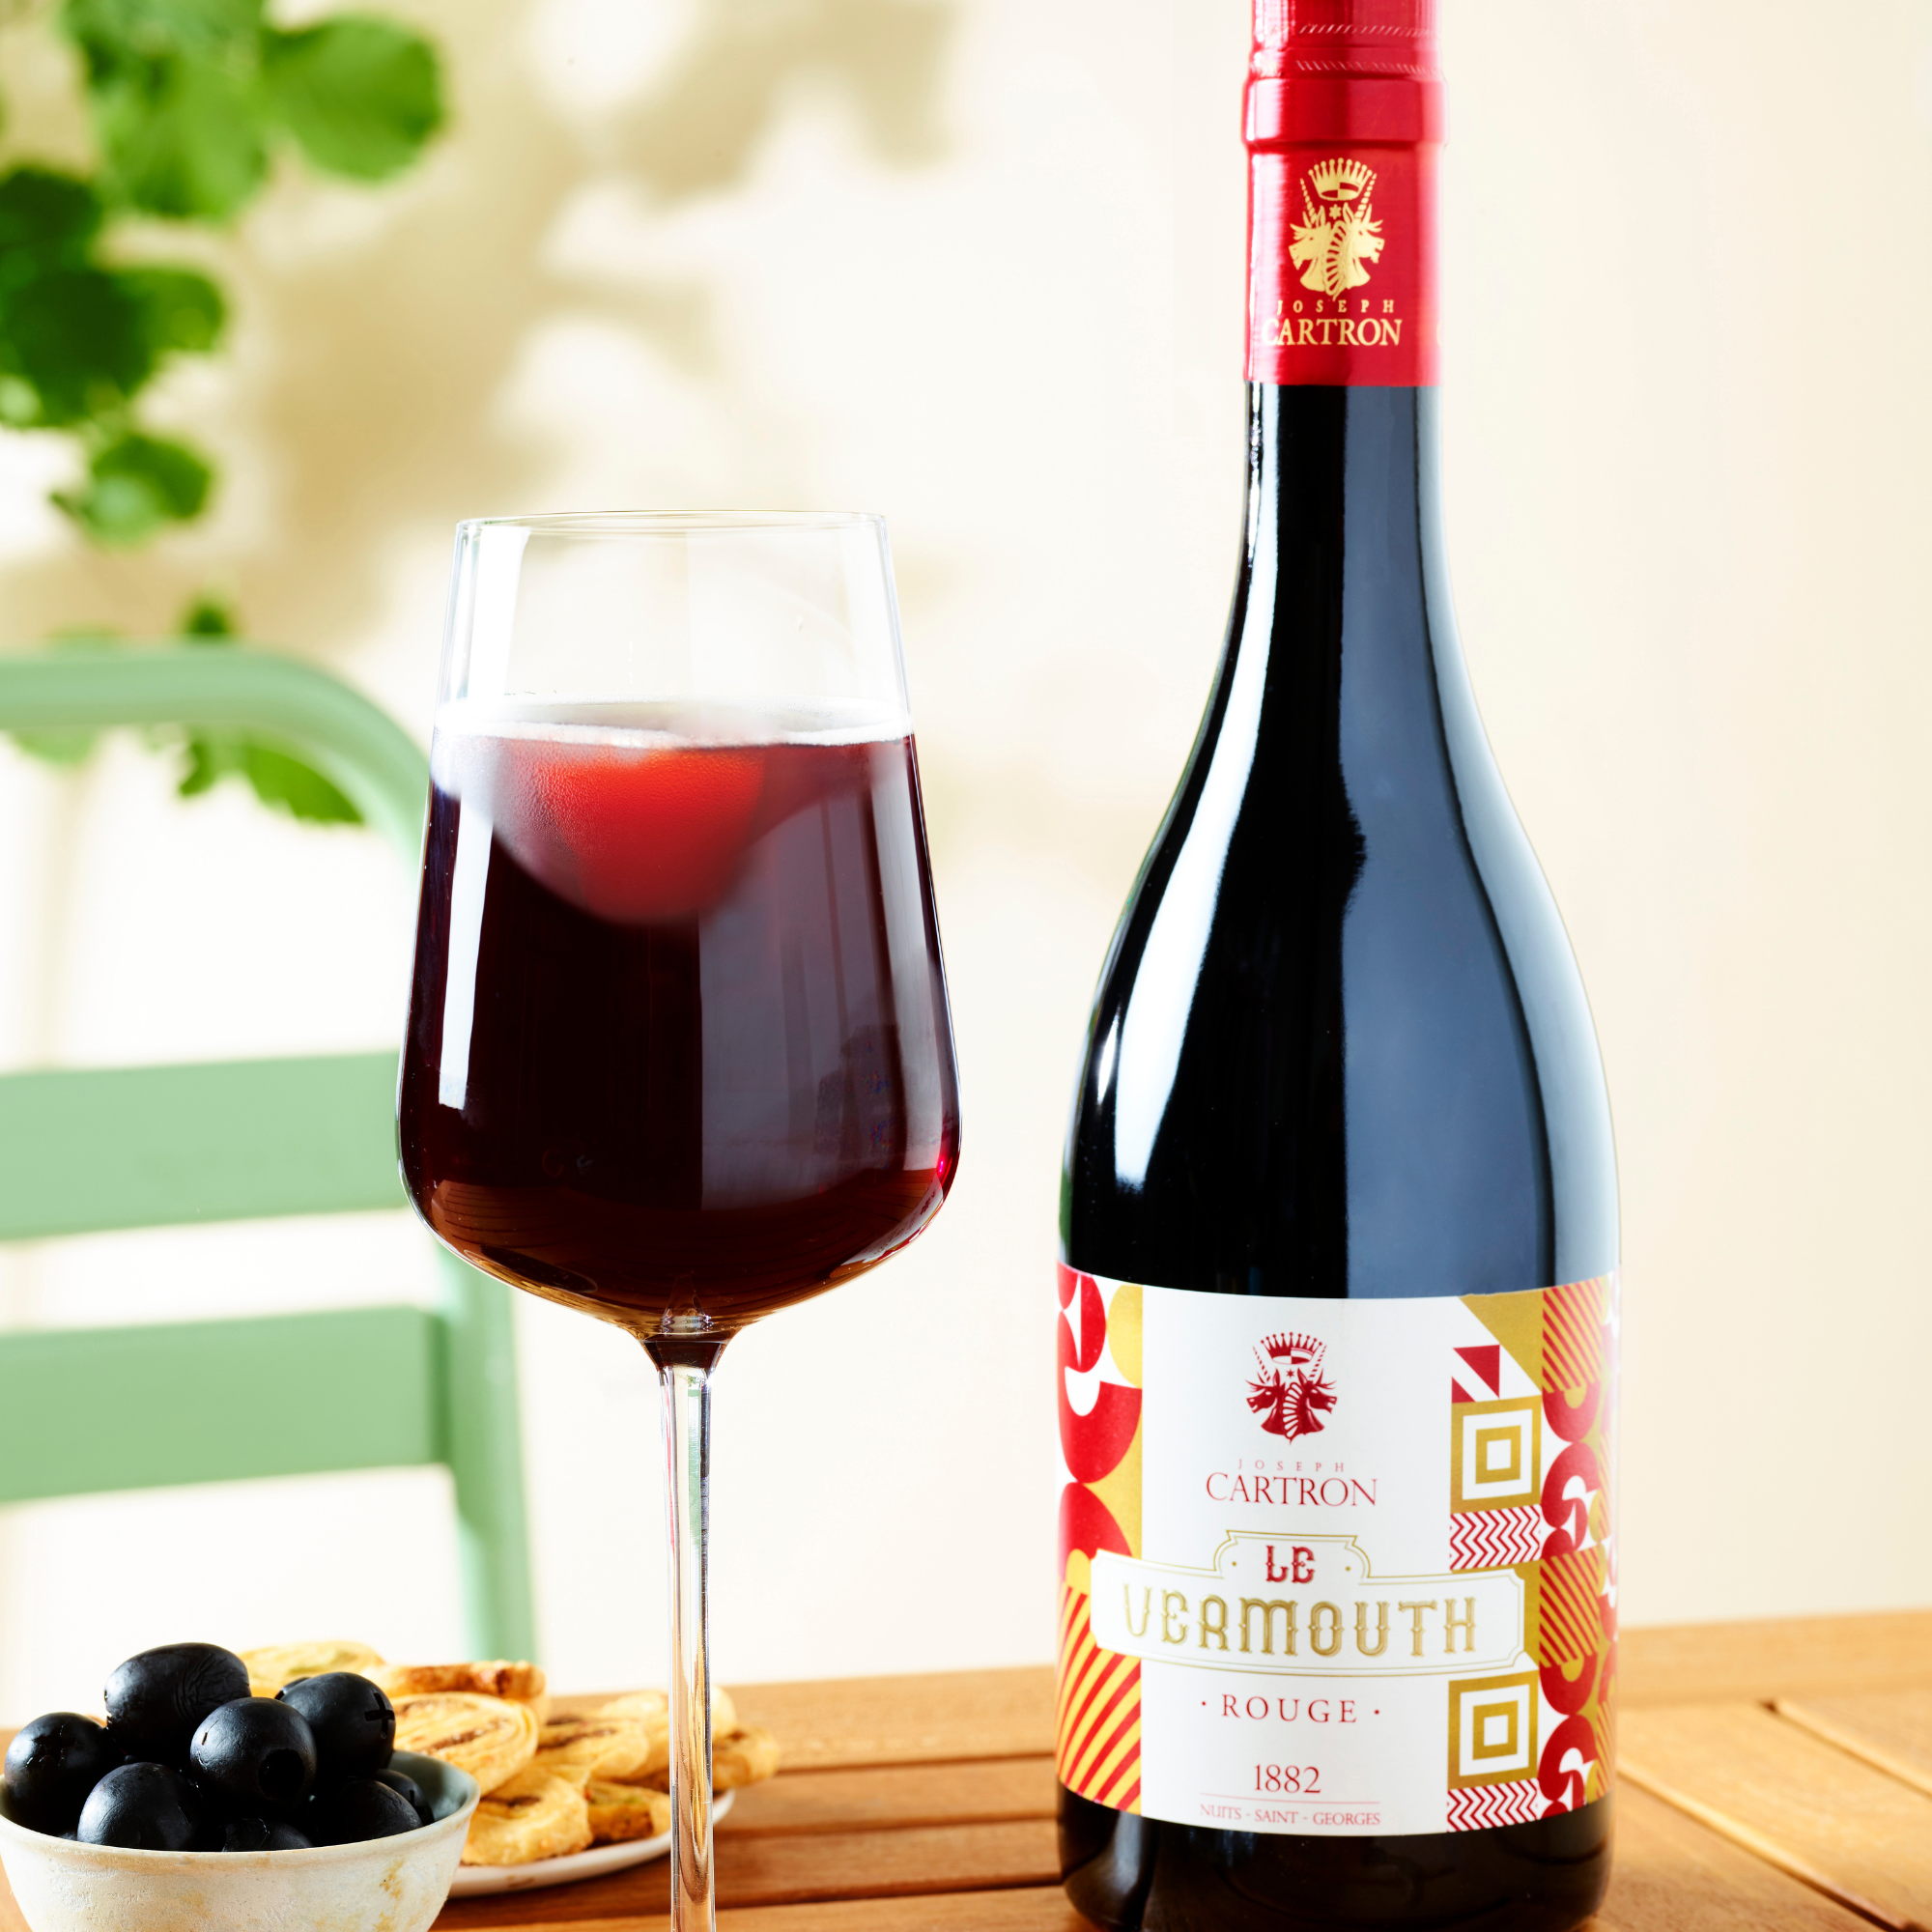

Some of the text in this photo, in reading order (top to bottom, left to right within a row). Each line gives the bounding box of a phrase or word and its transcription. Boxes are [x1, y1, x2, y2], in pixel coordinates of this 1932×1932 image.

[1276, 298, 1394, 316] JOSEPH
[1261, 318, 1403, 346] CARTRON
[1237, 1458, 1345, 1472] JOSEPH
[1207, 1471, 1378, 1507] CARTRON
[1265, 1545, 1315, 1583] LE
[1123, 1582, 1476, 1657] VERMOUTH
[1221, 1693, 1357, 1723] ROUGE
[1254, 1763, 1321, 1794] 1882
[1200, 1804, 1381, 1826] NUITS SAINT GEORGES
